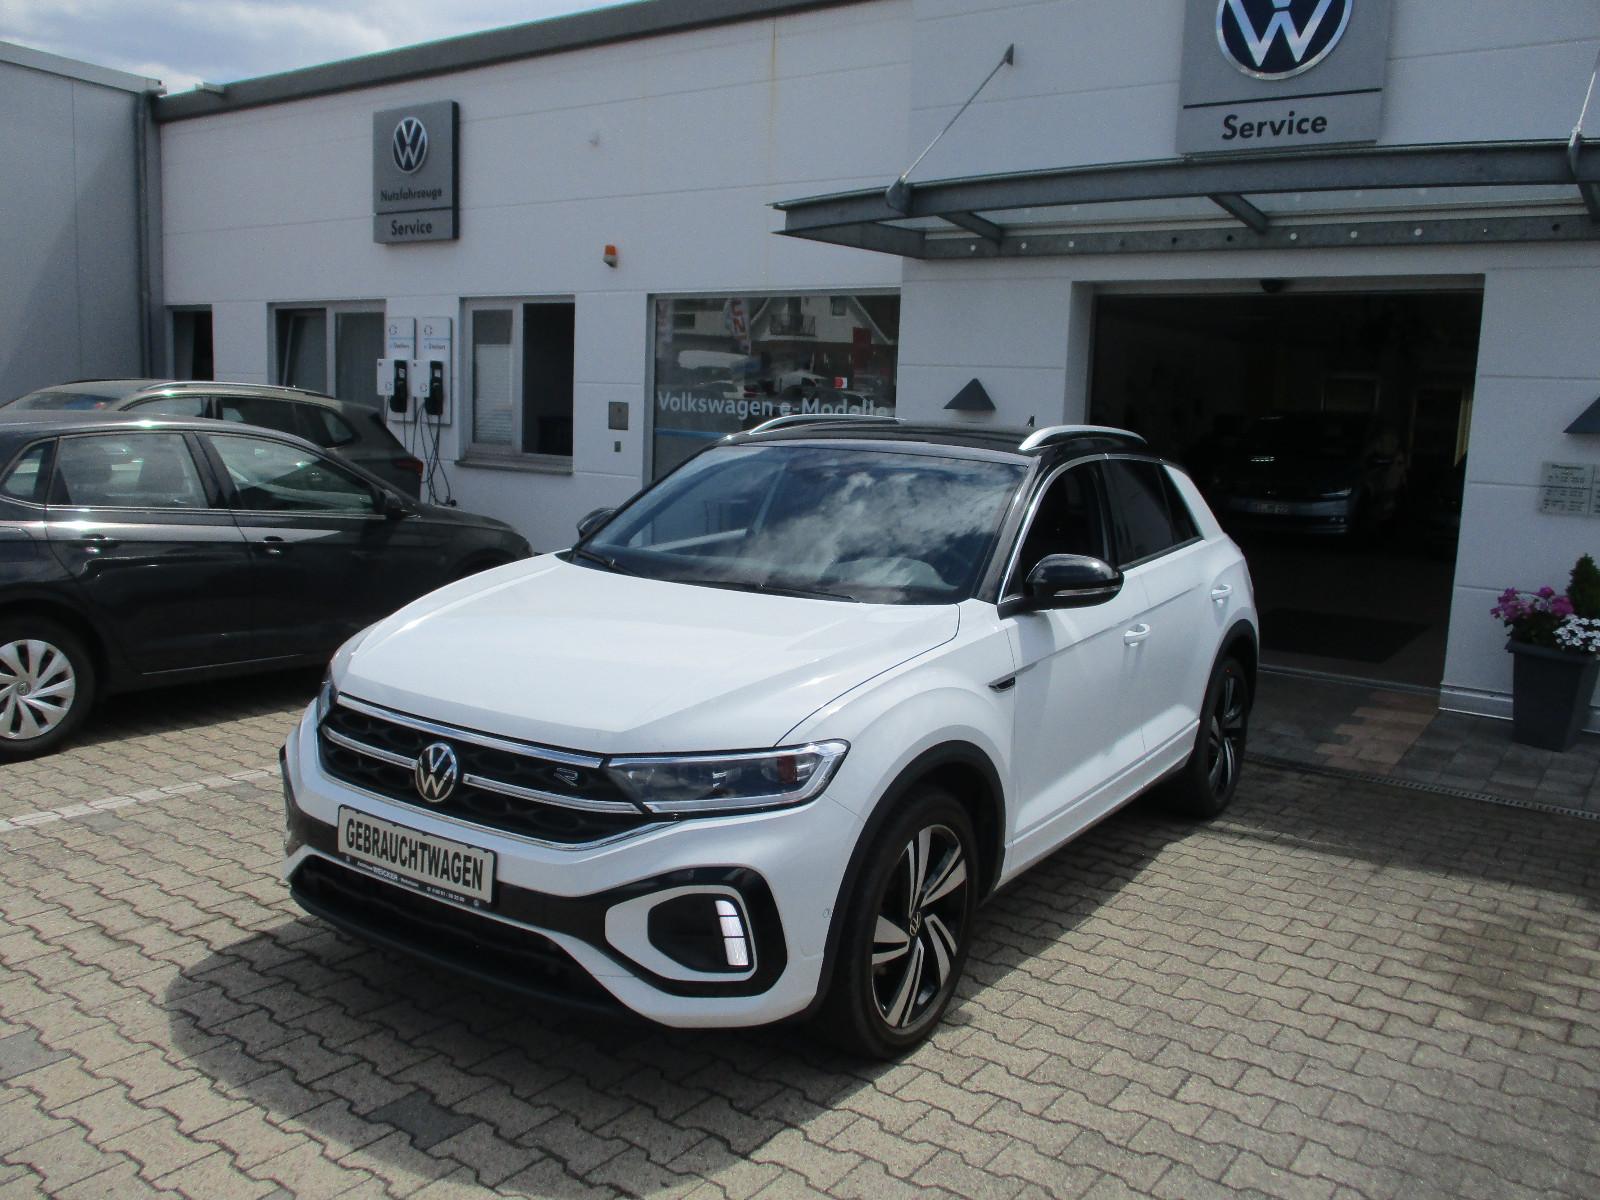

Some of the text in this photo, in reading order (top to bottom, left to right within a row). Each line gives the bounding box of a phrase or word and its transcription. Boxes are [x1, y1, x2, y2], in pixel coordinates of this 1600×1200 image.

[1222, 111, 1327, 140] Service
[391, 219, 432, 236] Service
[657, 391, 773, 420] Volkswagen
[346, 818, 484, 891] GEBRAUCHTWAGEN
